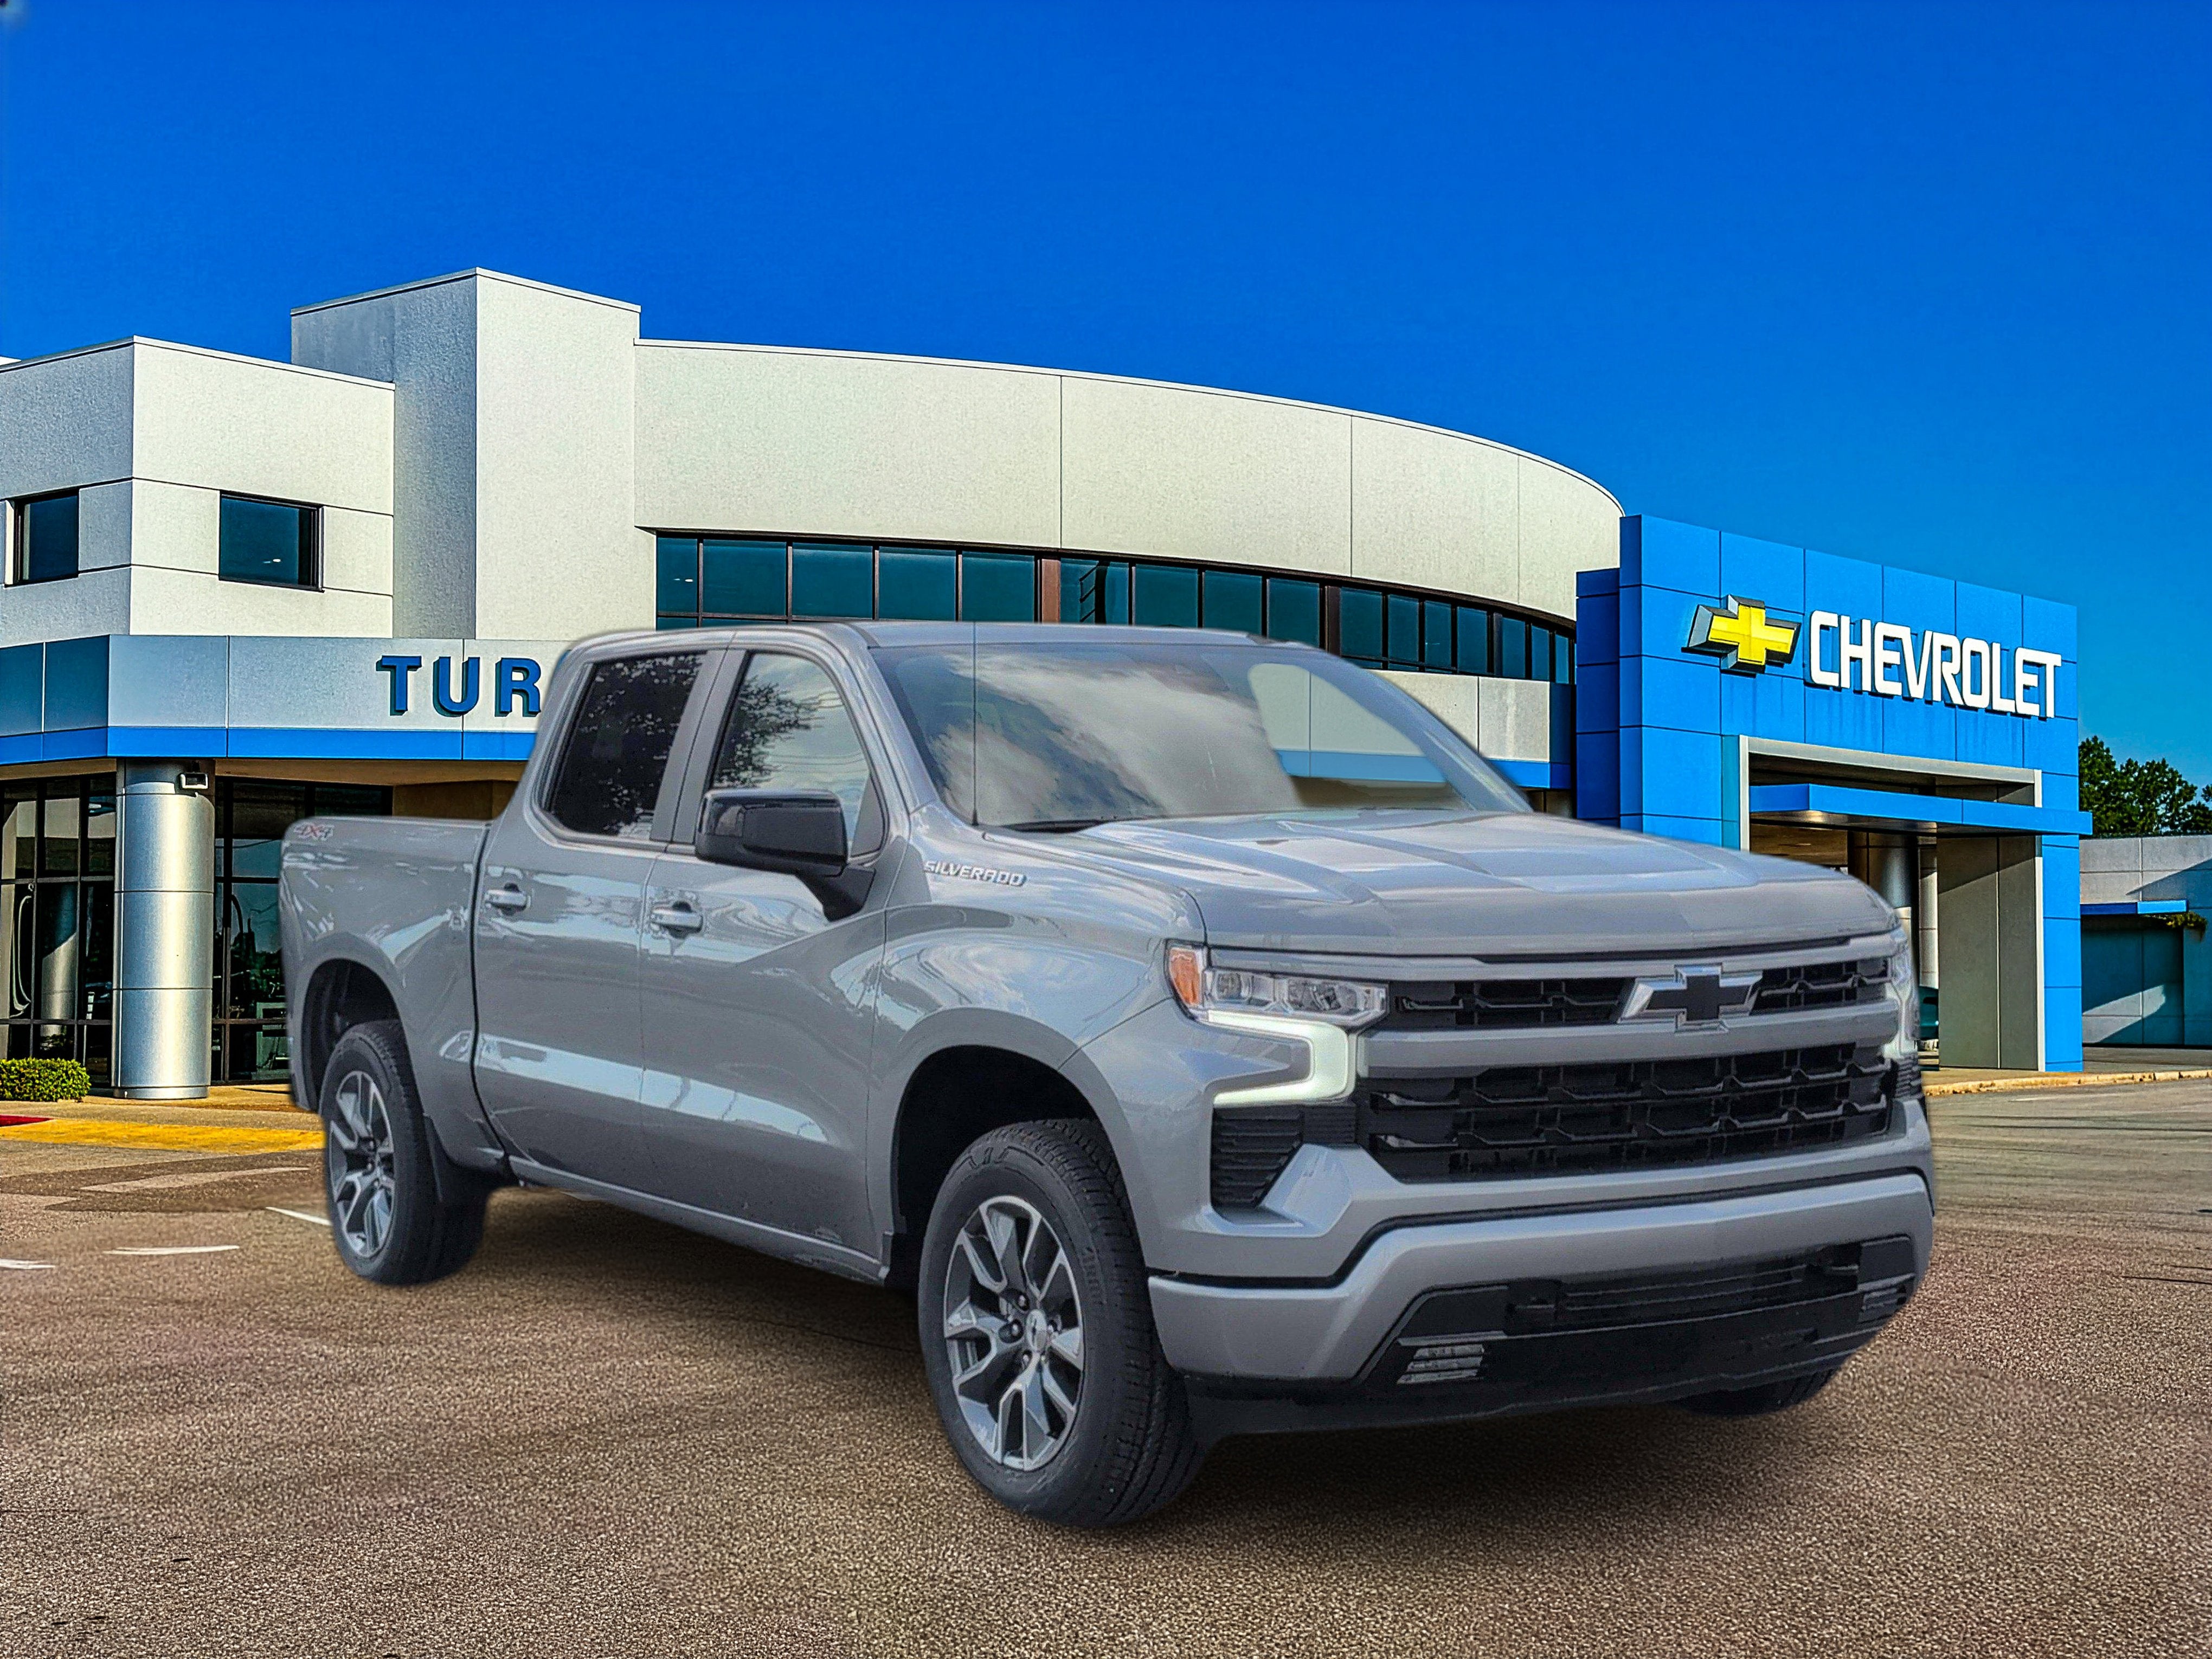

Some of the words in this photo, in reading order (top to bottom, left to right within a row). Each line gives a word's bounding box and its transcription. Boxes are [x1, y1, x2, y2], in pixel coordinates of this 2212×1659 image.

[376, 651, 569, 717] TUR
[1810, 610, 2062, 718] CHEVROLET
[923, 860, 1026, 887] SILVERADO
